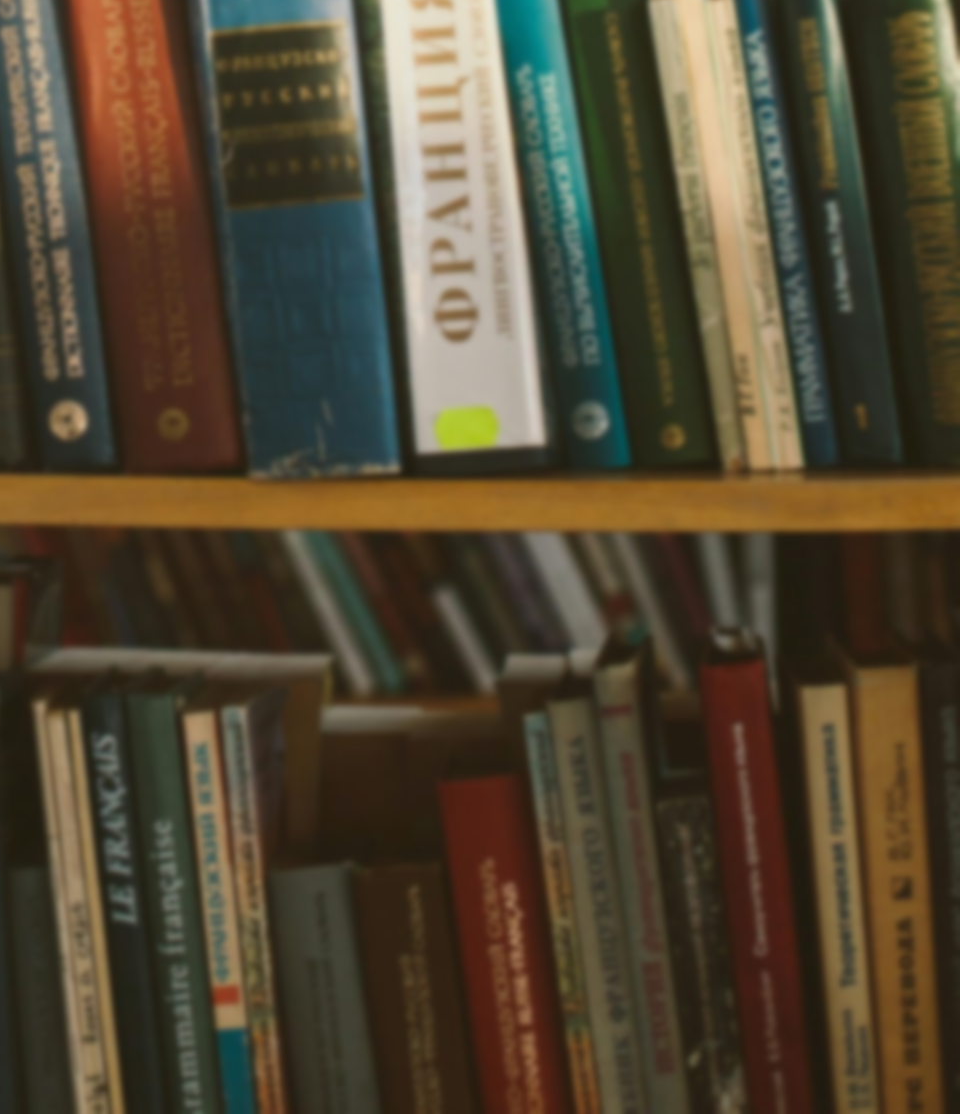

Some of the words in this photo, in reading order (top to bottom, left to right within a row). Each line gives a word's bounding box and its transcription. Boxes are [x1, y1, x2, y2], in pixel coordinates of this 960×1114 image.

[0, 25, 34, 158] ТЕХНИЧЕСКИЙ
[221, 75, 350, 110] РУССКИЙ
[516, 63, 541, 147] СЛОВАРЬ
[743, 28, 775, 102] ЯЗЫКА
[799, 17, 823, 92] DEUTSCH
[886, 10, 935, 95] СЛОВАРЬ
[539, 69, 568, 153] ТЕХНИКЕ
[38, 138, 69, 243] TECHNIQUE
[471, 66, 514, 341] ЛИНГВОСТРАНОВЕДЧЕСКИЙ
[551, 157, 597, 332] ВЫЧИСЛИТЕЛЬНОЙ
[758, 105, 802, 269] ФРАНЦУЗСКОГО
[15, 163, 60, 381] ФРАНЦУЗСКО-РУССКИЙ
[111, 99, 164, 393] ФРАНЦУЗСКО-РУССКИЙ
[154, 206, 195, 387] DICTIONNAIRE
[526, 149, 578, 369] ФРАНЦУЗСКО-РУССКИЙ
[49, 248, 84, 379] DICTIONNAIRE
[582, 334, 602, 365] ПО
[786, 273, 826, 423] ГРАММАТИКА
[657, 356, 676, 408] ЯЗЫКА
[193, 740, 213, 806] ЯЗЫК
[567, 735, 595, 817] ЯЗЫКА
[619, 751, 639, 812] языка
[730, 722, 746, 766] языка
[821, 723, 845, 836] грамматика
[90, 730, 132, 876] FRANÇAIS
[735, 768, 760, 866] французского
[110, 885, 139, 925] LE
[150, 819, 186, 955] française
[194, 812, 230, 984] ФРАНЦУЗСКИЙ
[478, 857, 502, 940] СЛОВАРЬ
[582, 829, 626, 1025] ФРАНЦУЗСКОГО
[627, 816, 659, 954] французского
[749, 869, 770, 958] Самоучитель
[829, 841, 856, 989] Теоретическая
[501, 881, 535, 1027] RUSSE-FRANÇAIS
[896, 916, 922, 1066] ПЕРЕВОДА
[641, 960, 676, 1075] ИСТОРИЯ
